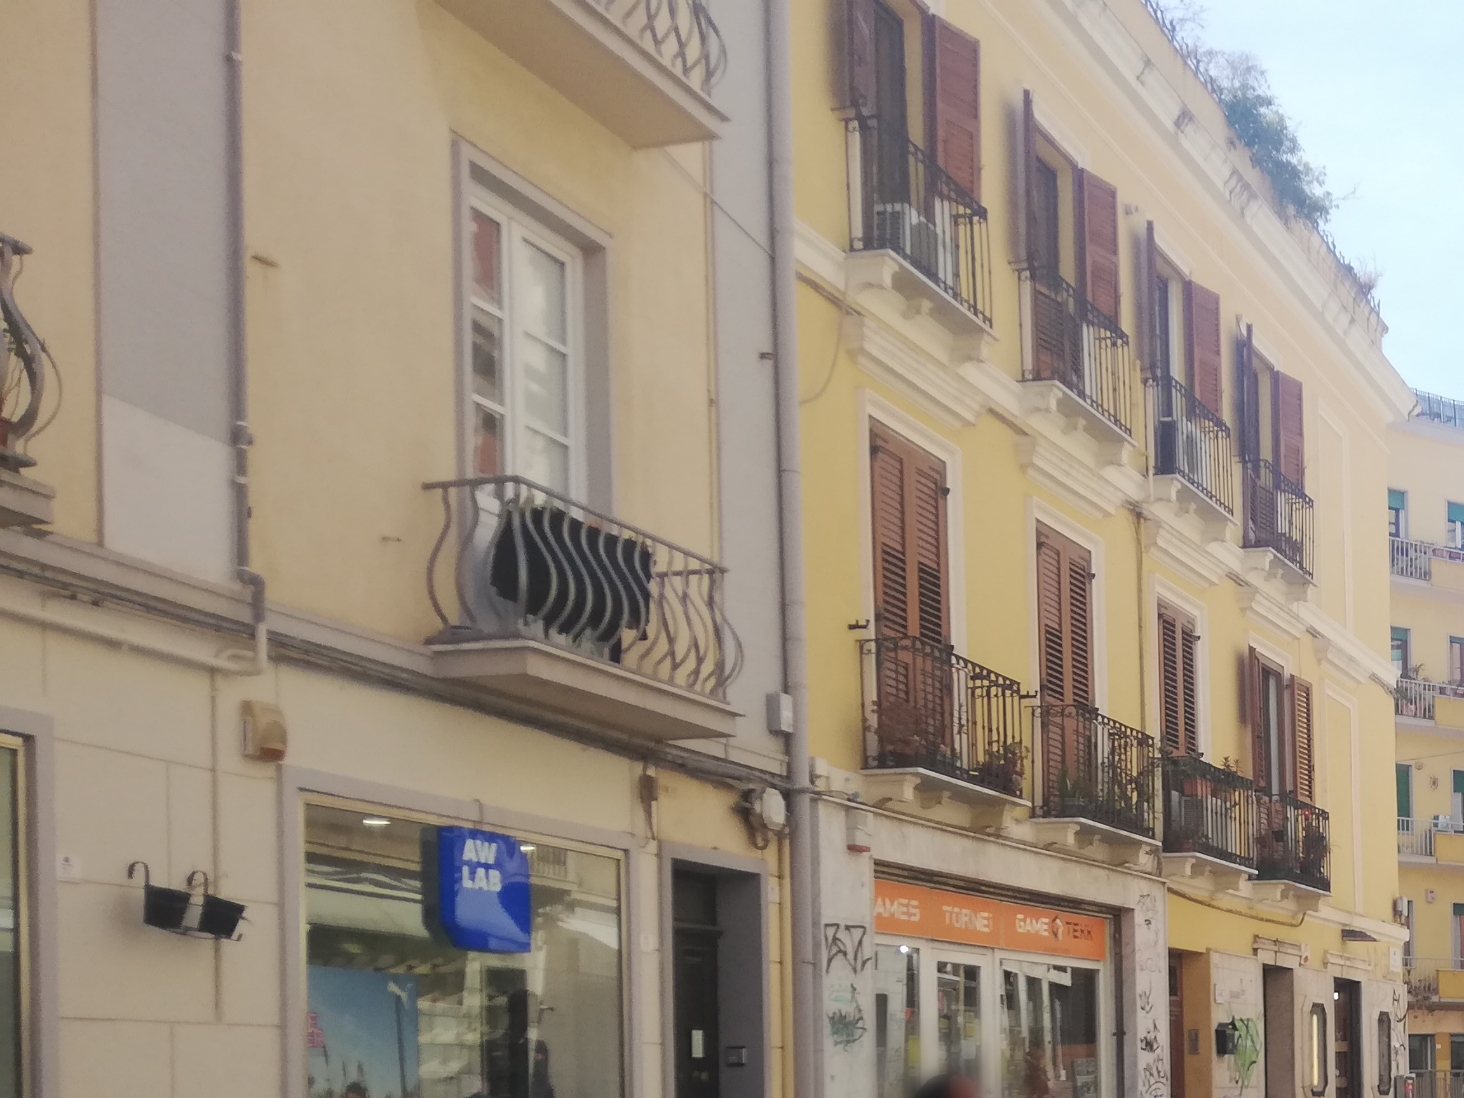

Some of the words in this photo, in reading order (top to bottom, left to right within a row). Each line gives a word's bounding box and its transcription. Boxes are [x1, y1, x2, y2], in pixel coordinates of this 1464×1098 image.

[462, 838, 498, 865] AW
[462, 864, 502, 892] LAB
[873, 896, 921, 922] AMES
[1015, 913, 1050, 937] GAME
